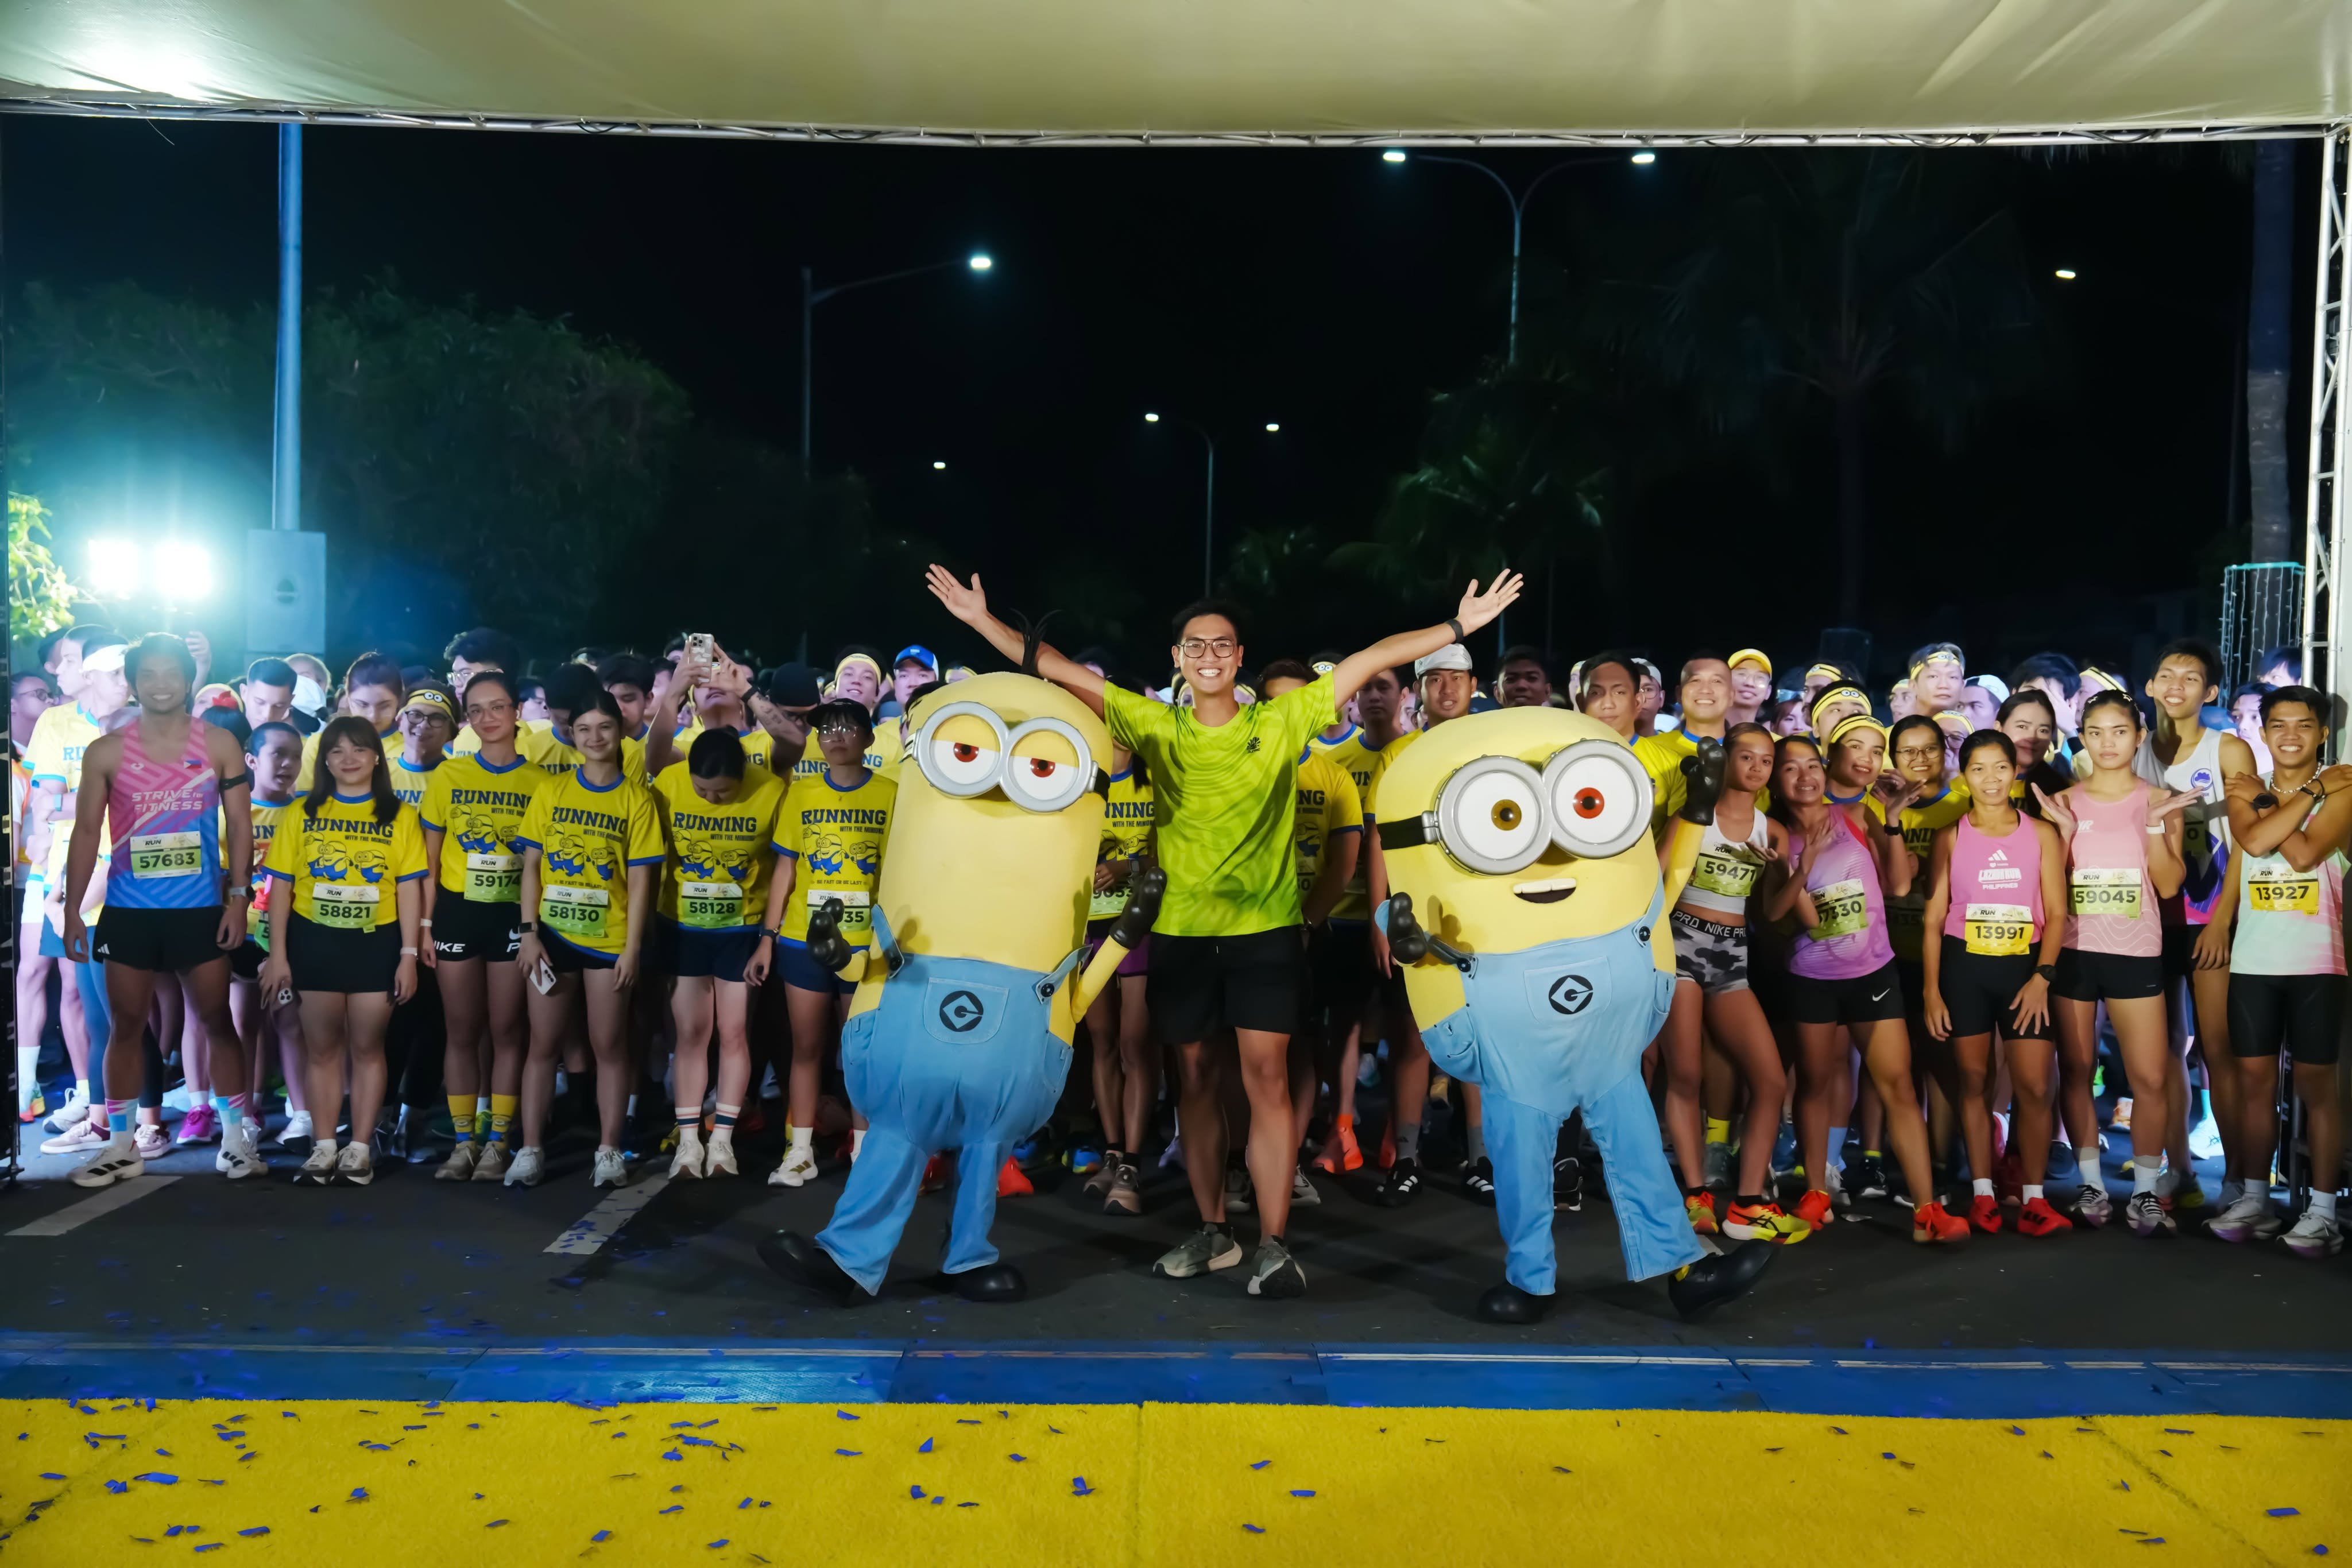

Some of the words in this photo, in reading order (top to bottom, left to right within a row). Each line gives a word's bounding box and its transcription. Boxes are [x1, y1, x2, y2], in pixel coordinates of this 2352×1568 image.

[131, 788, 193, 802] STRIVE
[451, 789, 532, 808] RUNNIN
[134, 801, 203, 813] FITNESS
[1104, 802, 1156, 818] NING
[672, 812, 757, 833] RUNNING
[802, 808, 887, 825] RUNNING
[302, 819, 394, 838] RUNNING
[140, 852, 195, 869] 57683
[1704, 861, 1757, 882] 59471
[2075, 891, 2136, 904] 59045
[2256, 885, 2310, 900] 13927
[319, 904, 370, 919] 58821
[548, 905, 599, 922] 58130
[689, 901, 736, 914] 58128
[1704, 922, 1731, 937] NIKE
[1975, 926, 2025, 939] 13991
